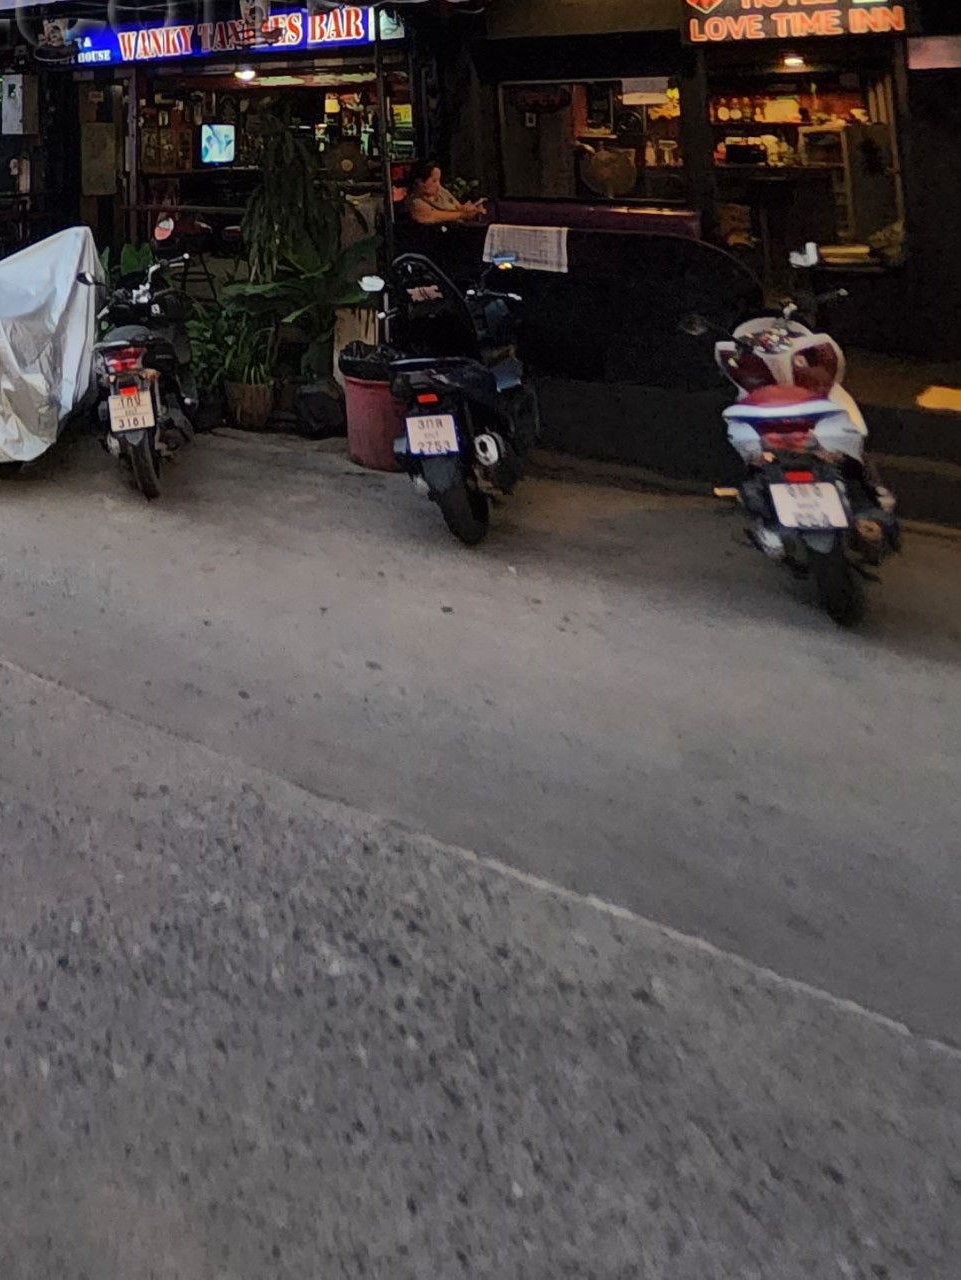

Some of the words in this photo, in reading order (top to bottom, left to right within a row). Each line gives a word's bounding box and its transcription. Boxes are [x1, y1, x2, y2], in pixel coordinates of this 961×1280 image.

[118, 24, 194, 61] WANKY
[308, 7, 364, 41] BAR
[689, 15, 765, 42] LOVE
[771, 9, 844, 38] TIME
[848, 5, 906, 34] INN
